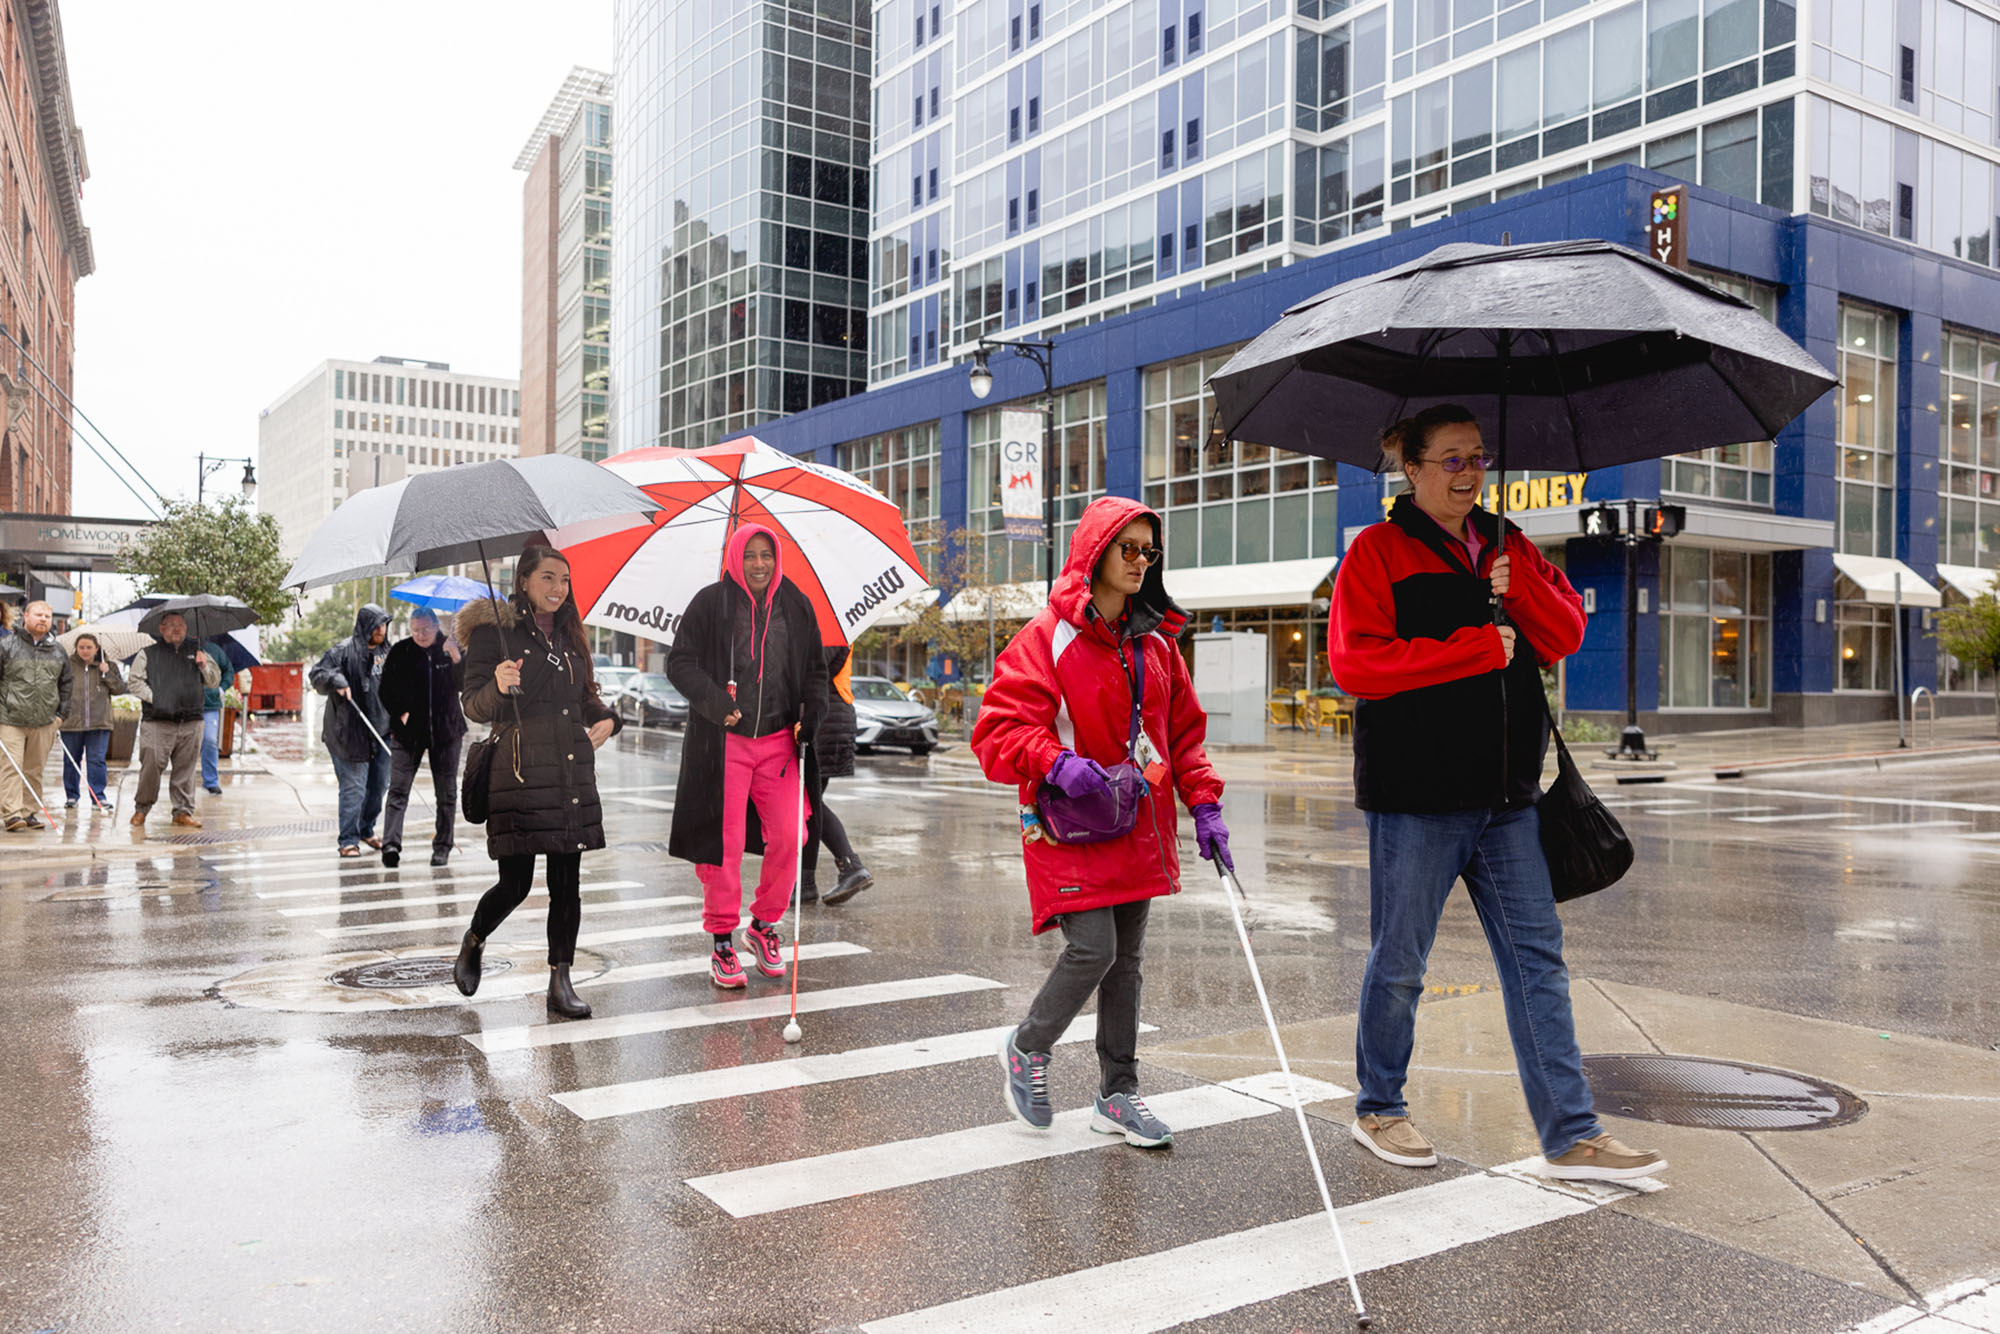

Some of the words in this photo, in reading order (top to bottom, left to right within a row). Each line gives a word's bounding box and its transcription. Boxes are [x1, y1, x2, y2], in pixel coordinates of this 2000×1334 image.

[1004, 441, 1037, 463] GR
[1489, 473, 1588, 514] HONEY
[38, 527, 130, 542] HOMEWOOD
